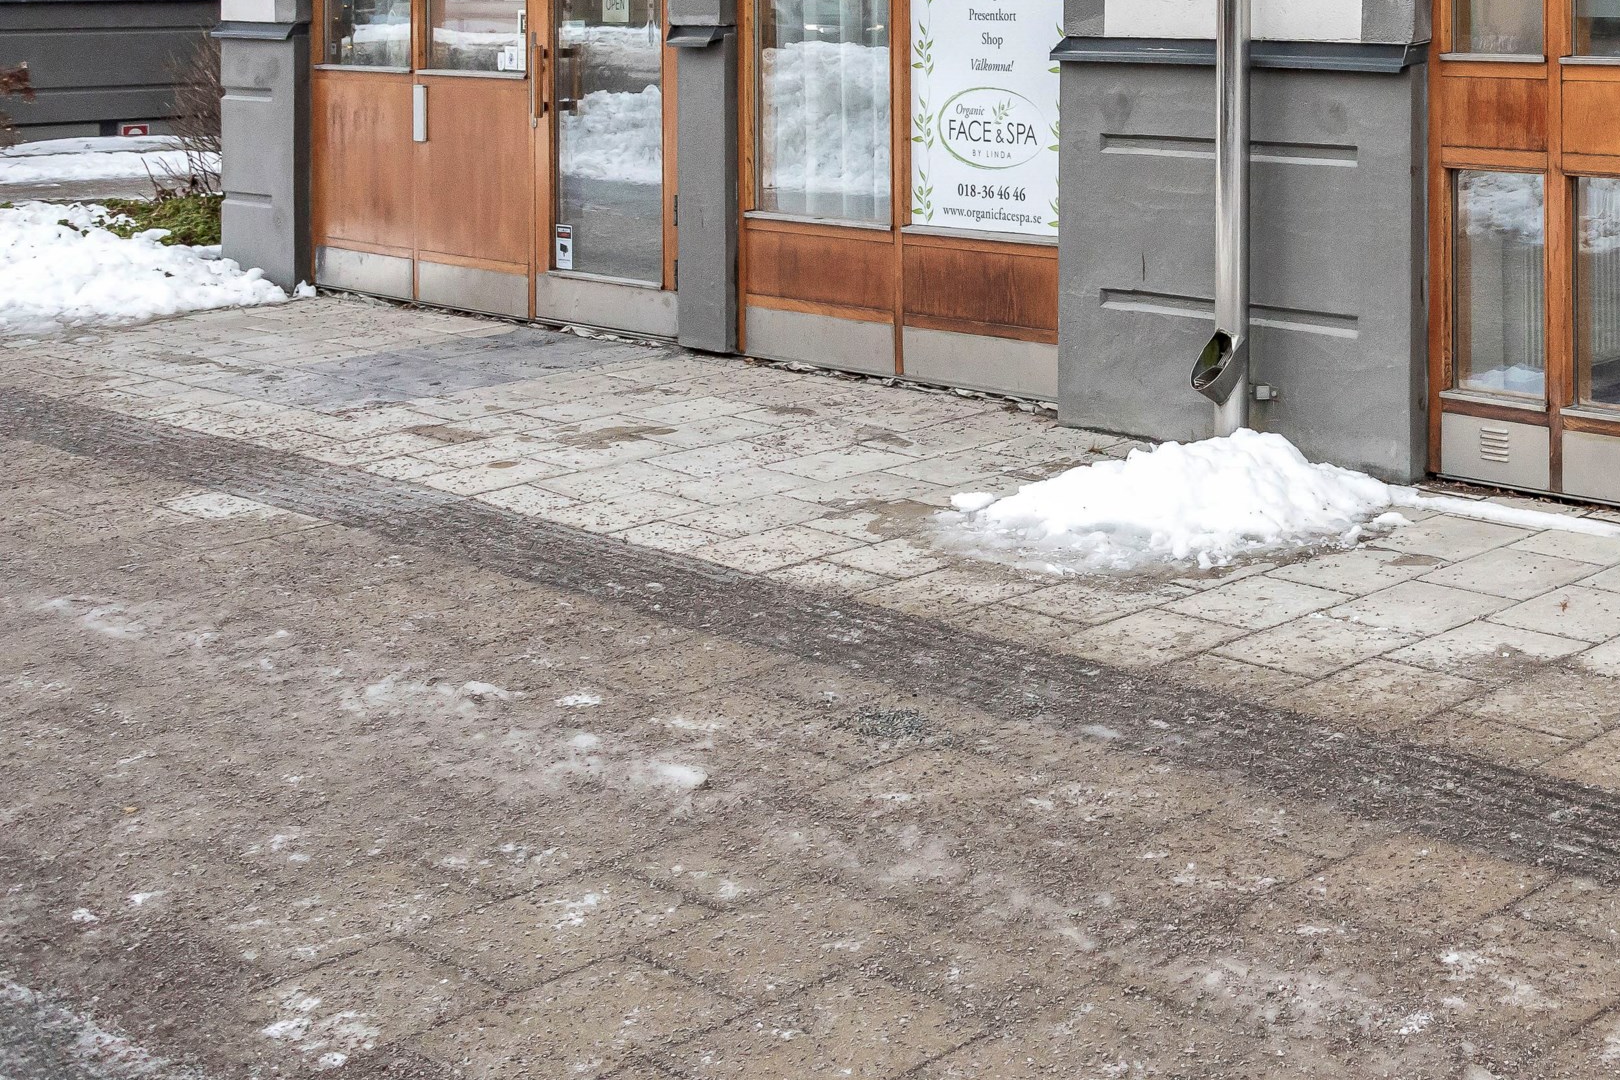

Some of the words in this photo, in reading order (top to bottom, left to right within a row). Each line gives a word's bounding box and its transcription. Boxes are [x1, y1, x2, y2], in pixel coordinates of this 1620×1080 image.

[969, 9, 1016, 22] Presentkort
[982, 33, 1003, 49] Shop
[971, 59, 1014, 72] Välkomna!
[956, 104, 985, 118] Organic
[949, 120, 991, 143] FACE
[996, 128, 1005, 144] &
[1007, 122, 1038, 145] SPA
[972, 149, 982, 158] BY
[986, 150, 1012, 159] LINDA
[958, 183, 995, 199] 018-36
[997, 185, 1010, 200] 46
[1012, 187, 1026, 202] 46
[943, 205, 1042, 225] www.organicfacespa.se
